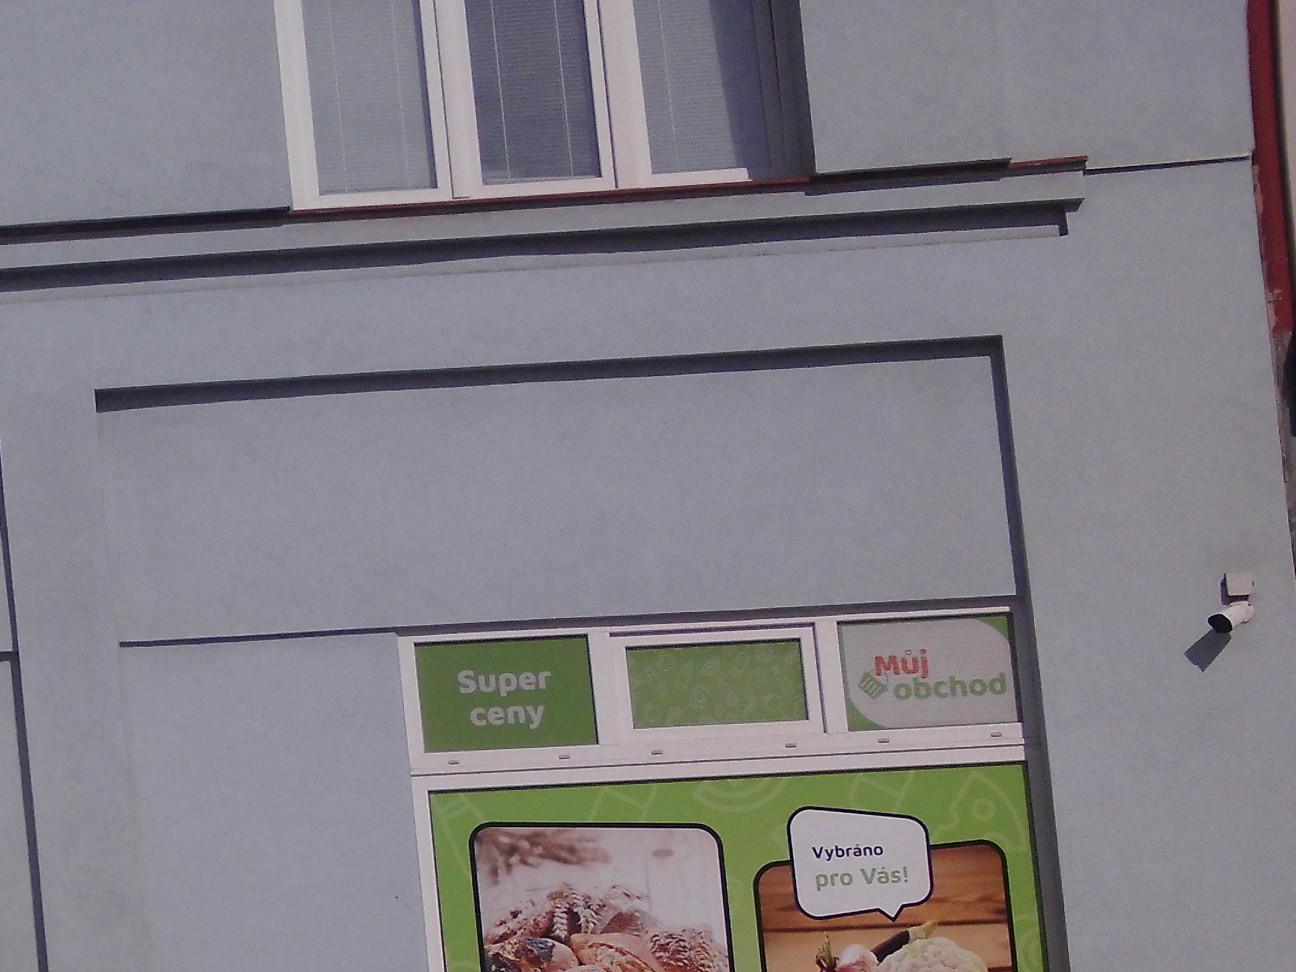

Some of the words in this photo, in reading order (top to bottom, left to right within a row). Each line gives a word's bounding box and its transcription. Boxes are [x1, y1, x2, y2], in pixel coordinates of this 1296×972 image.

[875, 649, 931, 682] Můj
[458, 668, 552, 696] Super
[893, 674, 1007, 702] obchod
[470, 704, 545, 728] ceny
[812, 844, 884, 862] Vybráno
[815, 870, 854, 892] pro
[860, 866, 909, 885] Vás!
